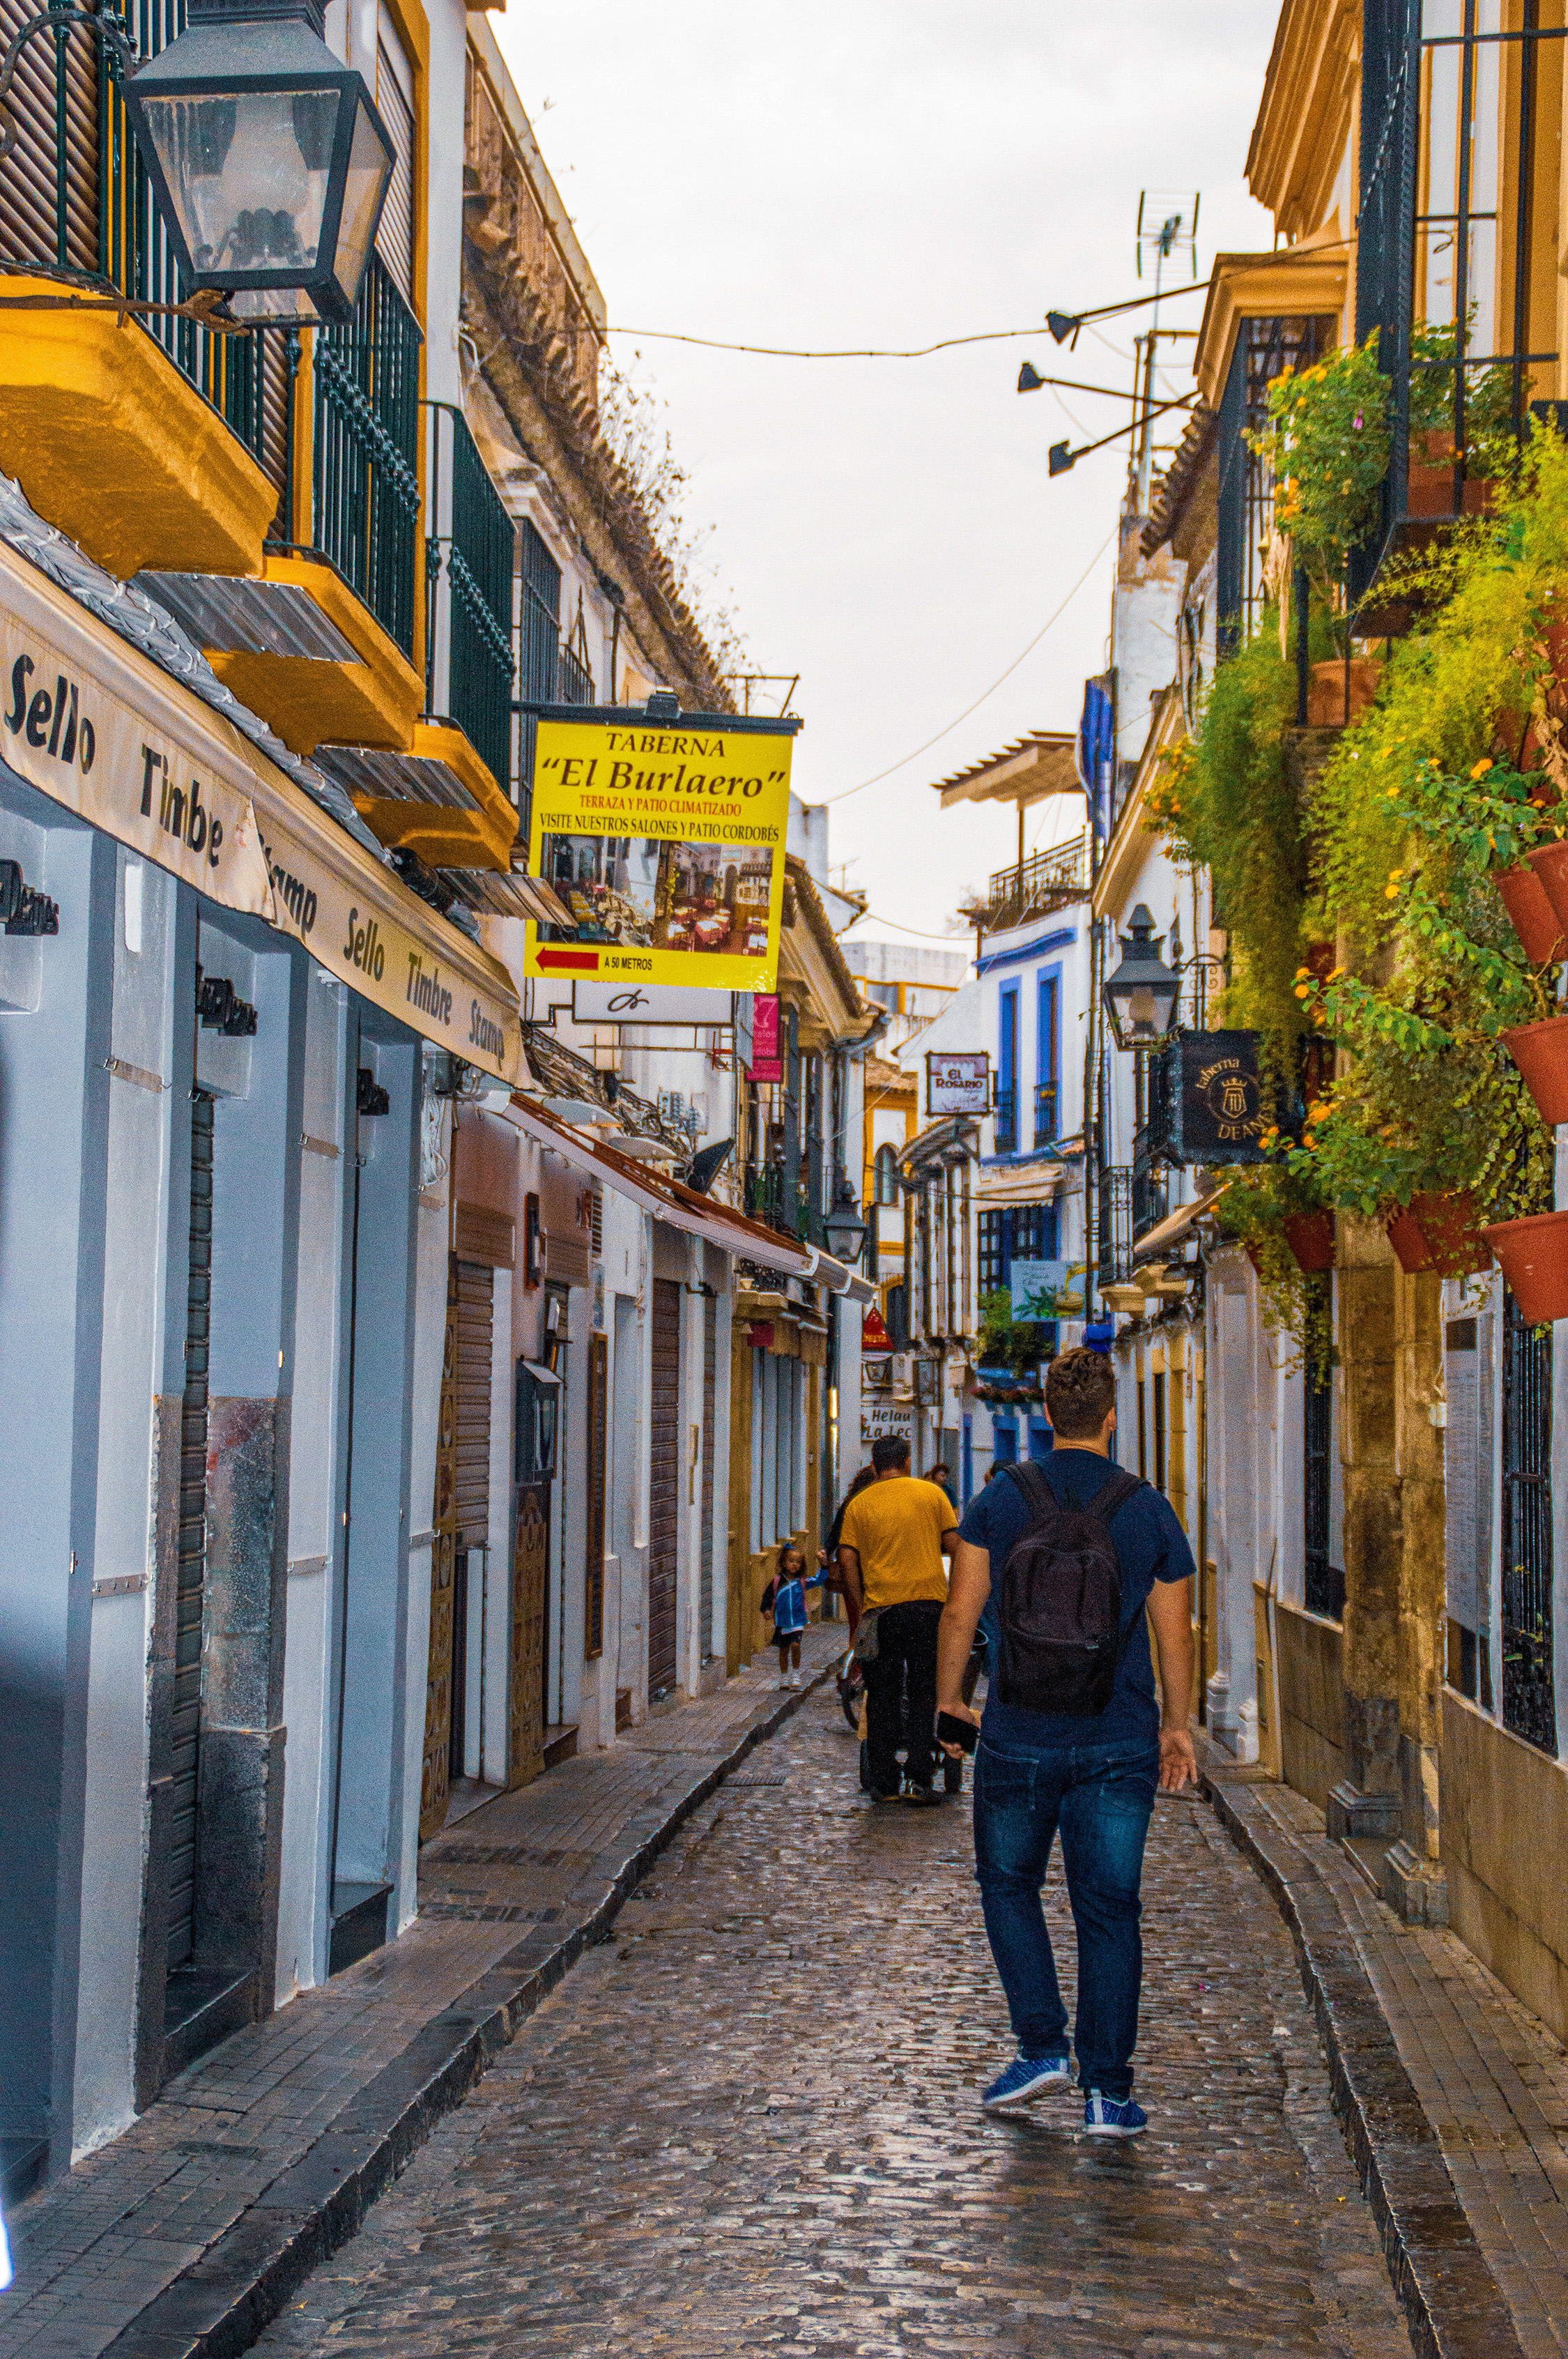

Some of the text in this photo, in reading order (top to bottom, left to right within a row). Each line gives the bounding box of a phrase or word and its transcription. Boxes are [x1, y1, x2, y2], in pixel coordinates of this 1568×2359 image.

[4, 653, 96, 775] Sello
[606, 732, 726, 758] TABERNA
[579, 794, 742, 818] TERRAZA Y PATIO CLIMATIZADO
[539, 812, 780, 843] VISITE NUESTROS SALONES Y PATIO CORDOBÉS
[604, 956, 653, 971] A 50 METROS
[343, 907, 385, 982] Sello
[406, 952, 453, 1027] Timbre
[468, 998, 505, 1072] Stamp
[1194, 1058, 1240, 1090] taberna
